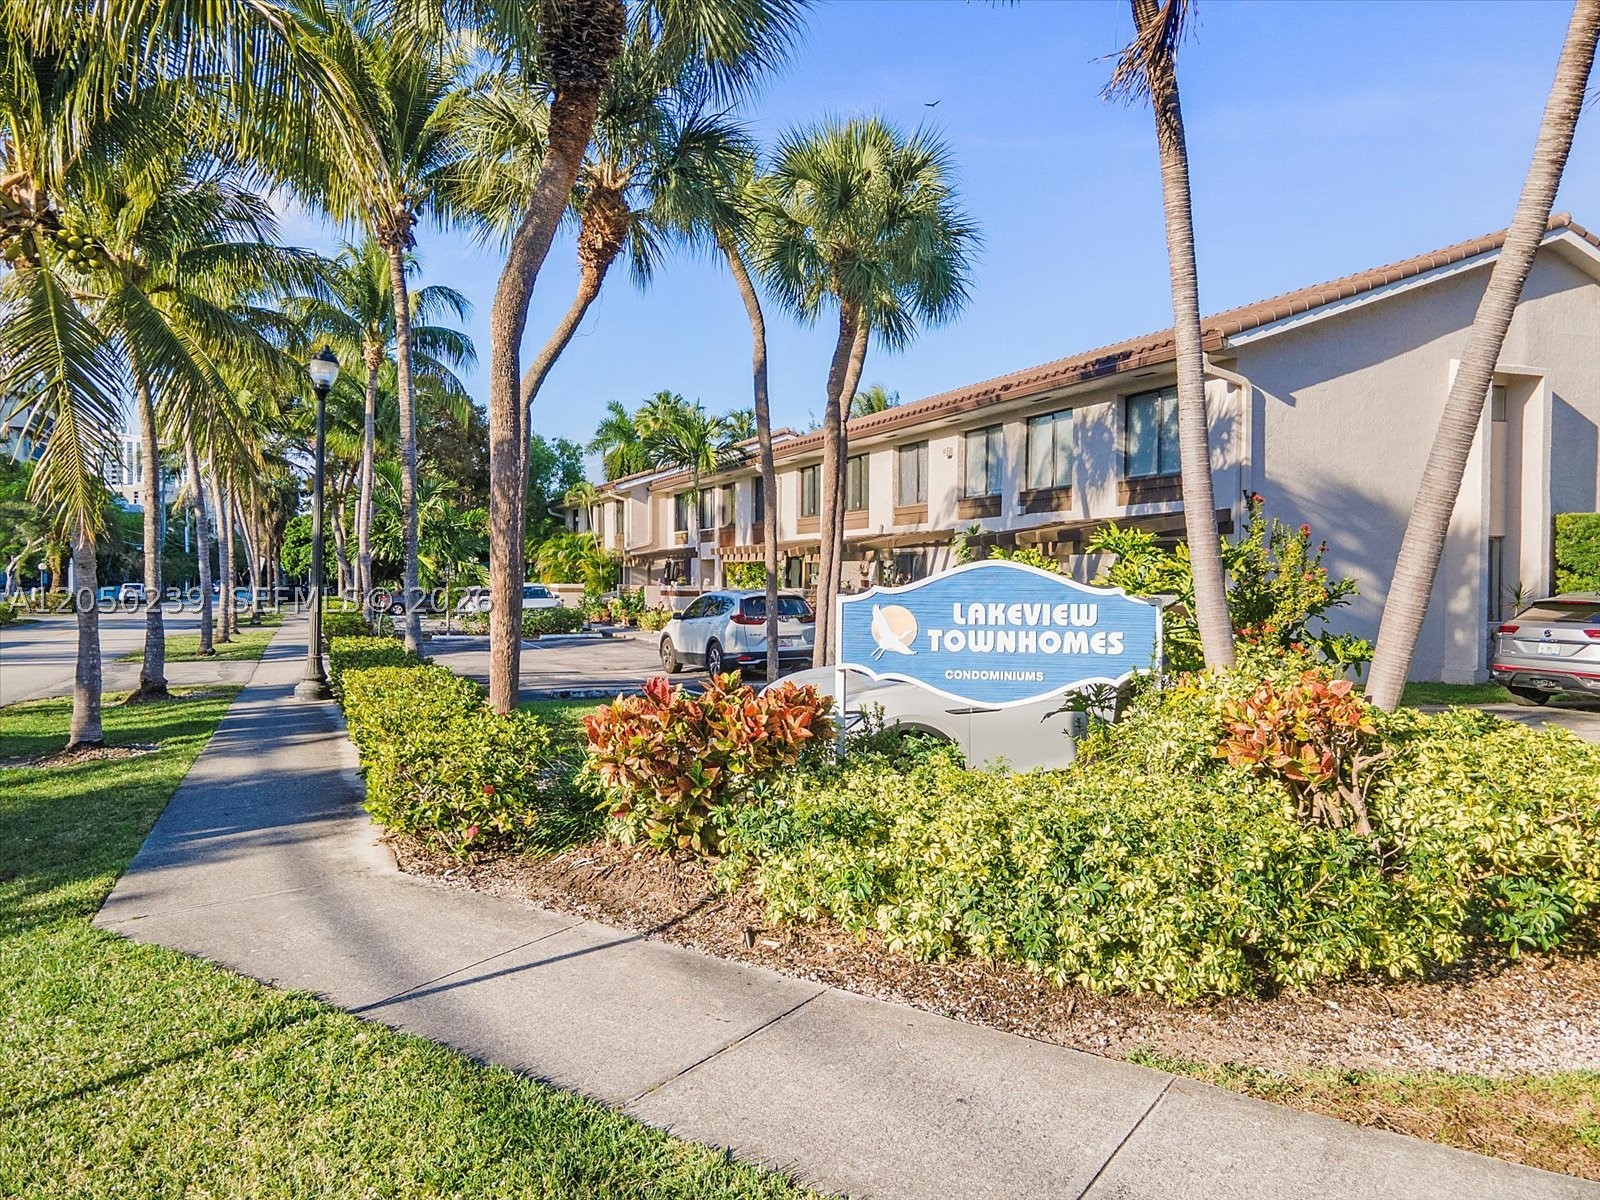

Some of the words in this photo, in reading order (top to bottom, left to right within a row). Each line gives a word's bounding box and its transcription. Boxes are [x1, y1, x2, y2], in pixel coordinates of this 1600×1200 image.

[952, 602, 1098, 627] LAKEVIEW
[927, 629, 1125, 655] TOWNHOMES
[944, 669, 1045, 683] CONDOMINIUMS
